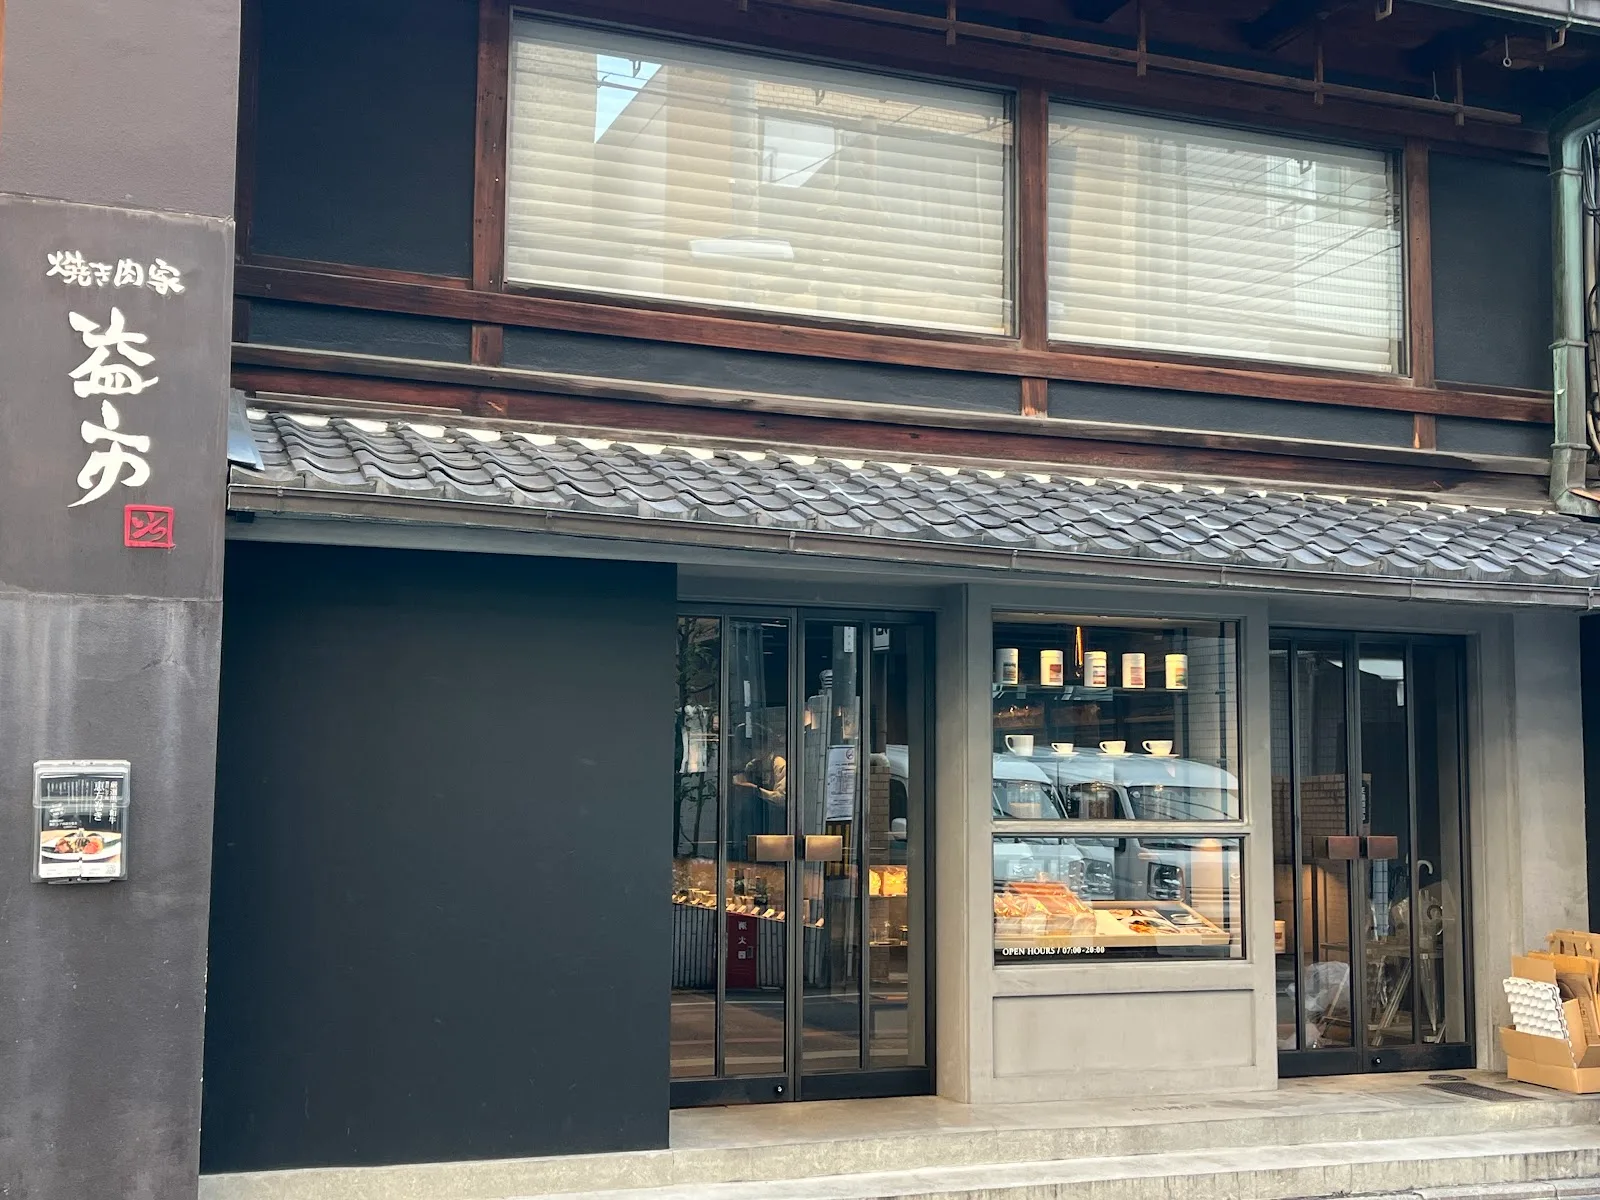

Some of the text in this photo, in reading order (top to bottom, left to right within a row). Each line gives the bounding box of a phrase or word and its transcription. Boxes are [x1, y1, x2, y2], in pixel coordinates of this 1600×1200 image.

[46, 250, 186, 295] 焼き肉家
[1002, 947, 1026, 956] OPEN
[1027, 946, 1055, 956] HOURS
